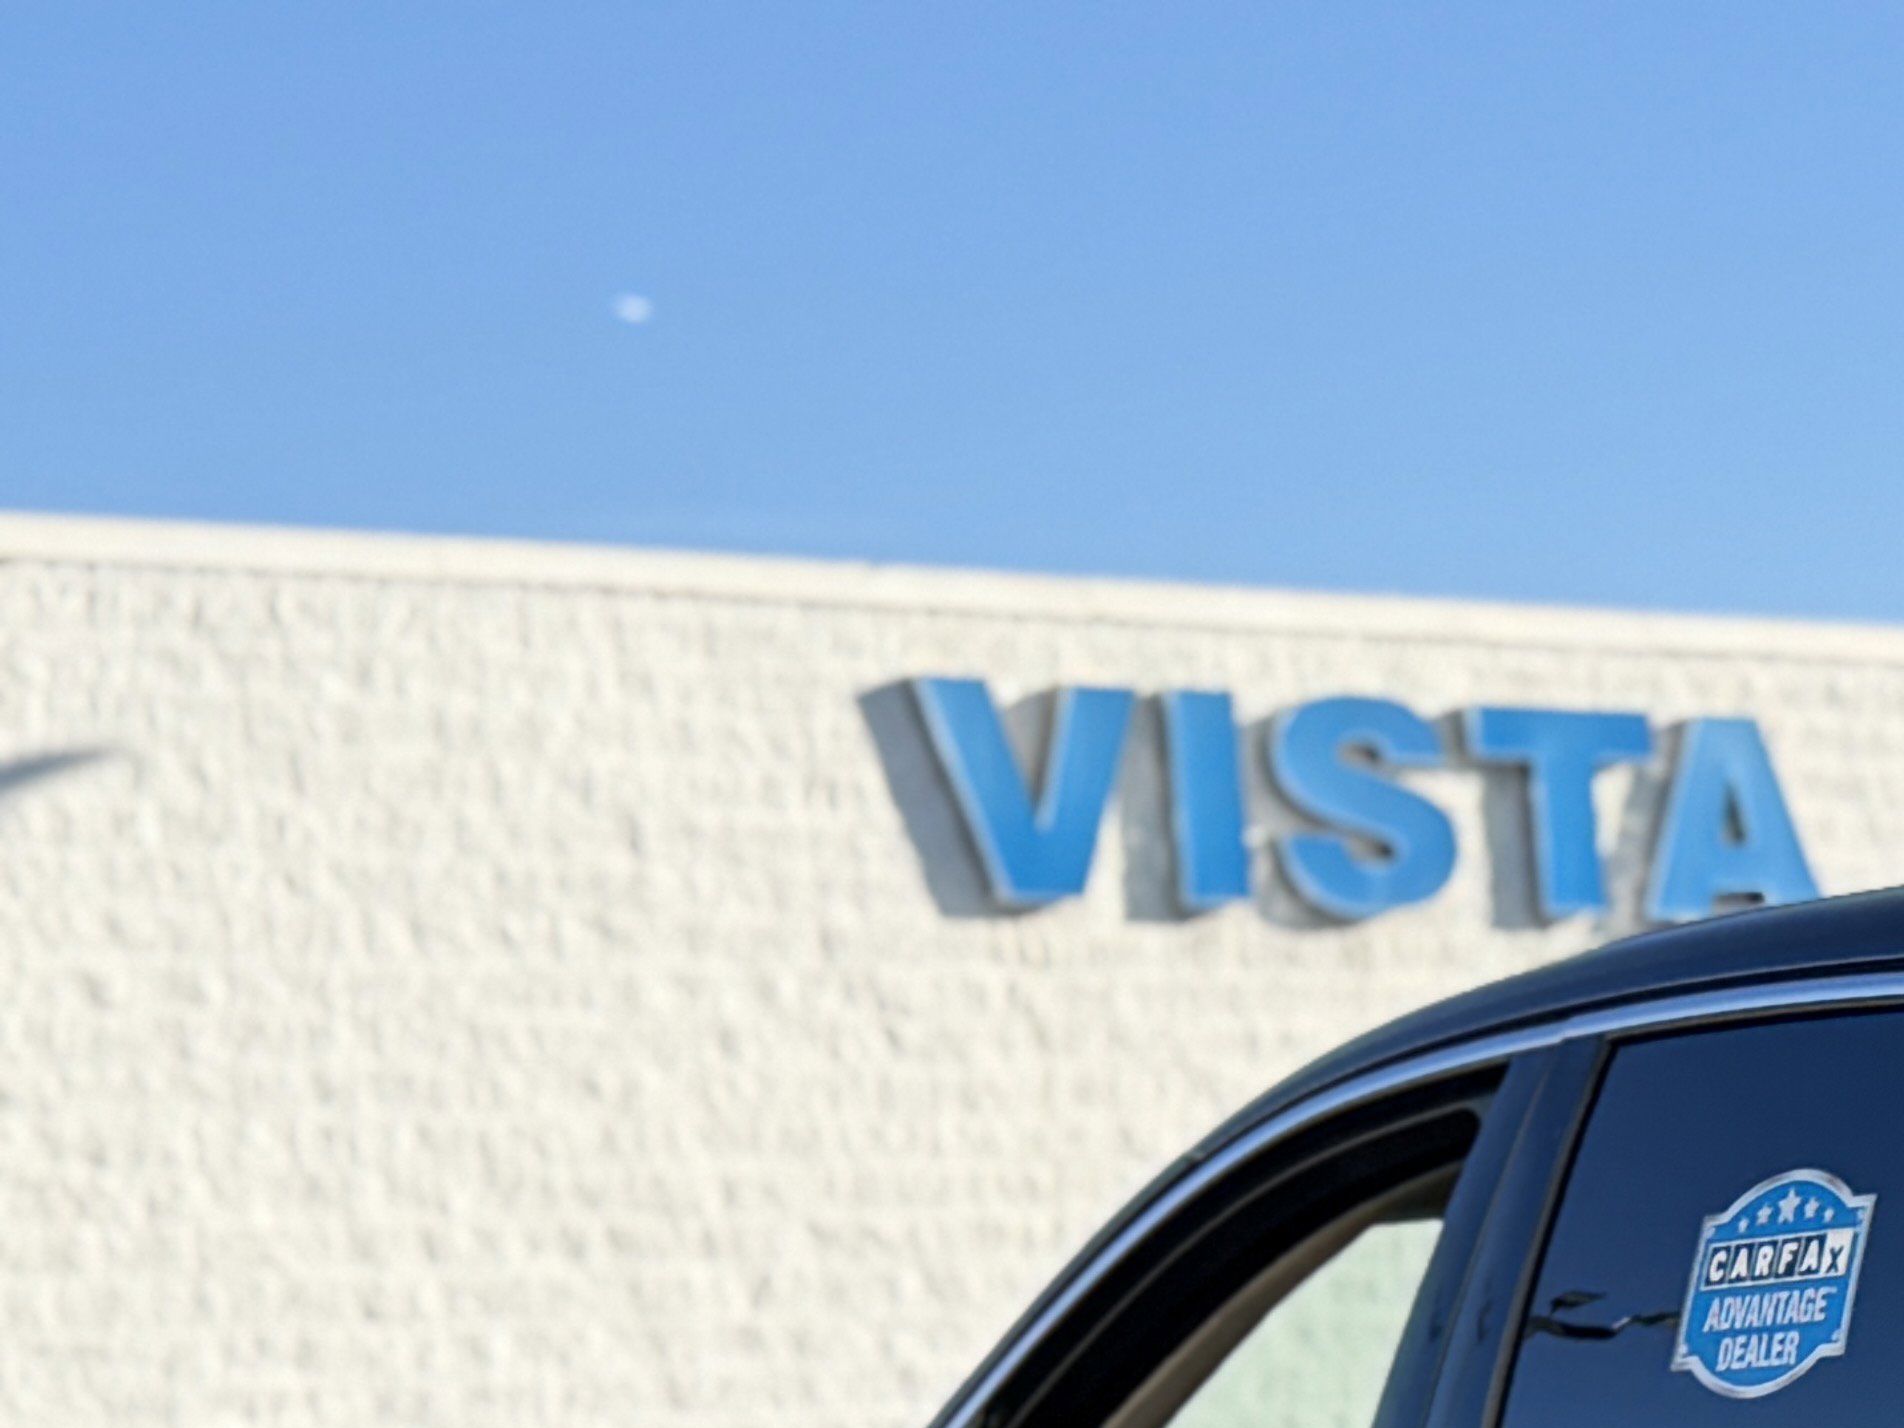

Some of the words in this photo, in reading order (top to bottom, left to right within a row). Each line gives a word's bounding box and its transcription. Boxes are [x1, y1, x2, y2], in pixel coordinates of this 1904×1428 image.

[868, 676, 1822, 926] VISTA
[1708, 1243, 1845, 1283] CARFAX
[1702, 1289, 1830, 1333] ADVANTAGE
[1715, 1332, 1799, 1371] DEALER
